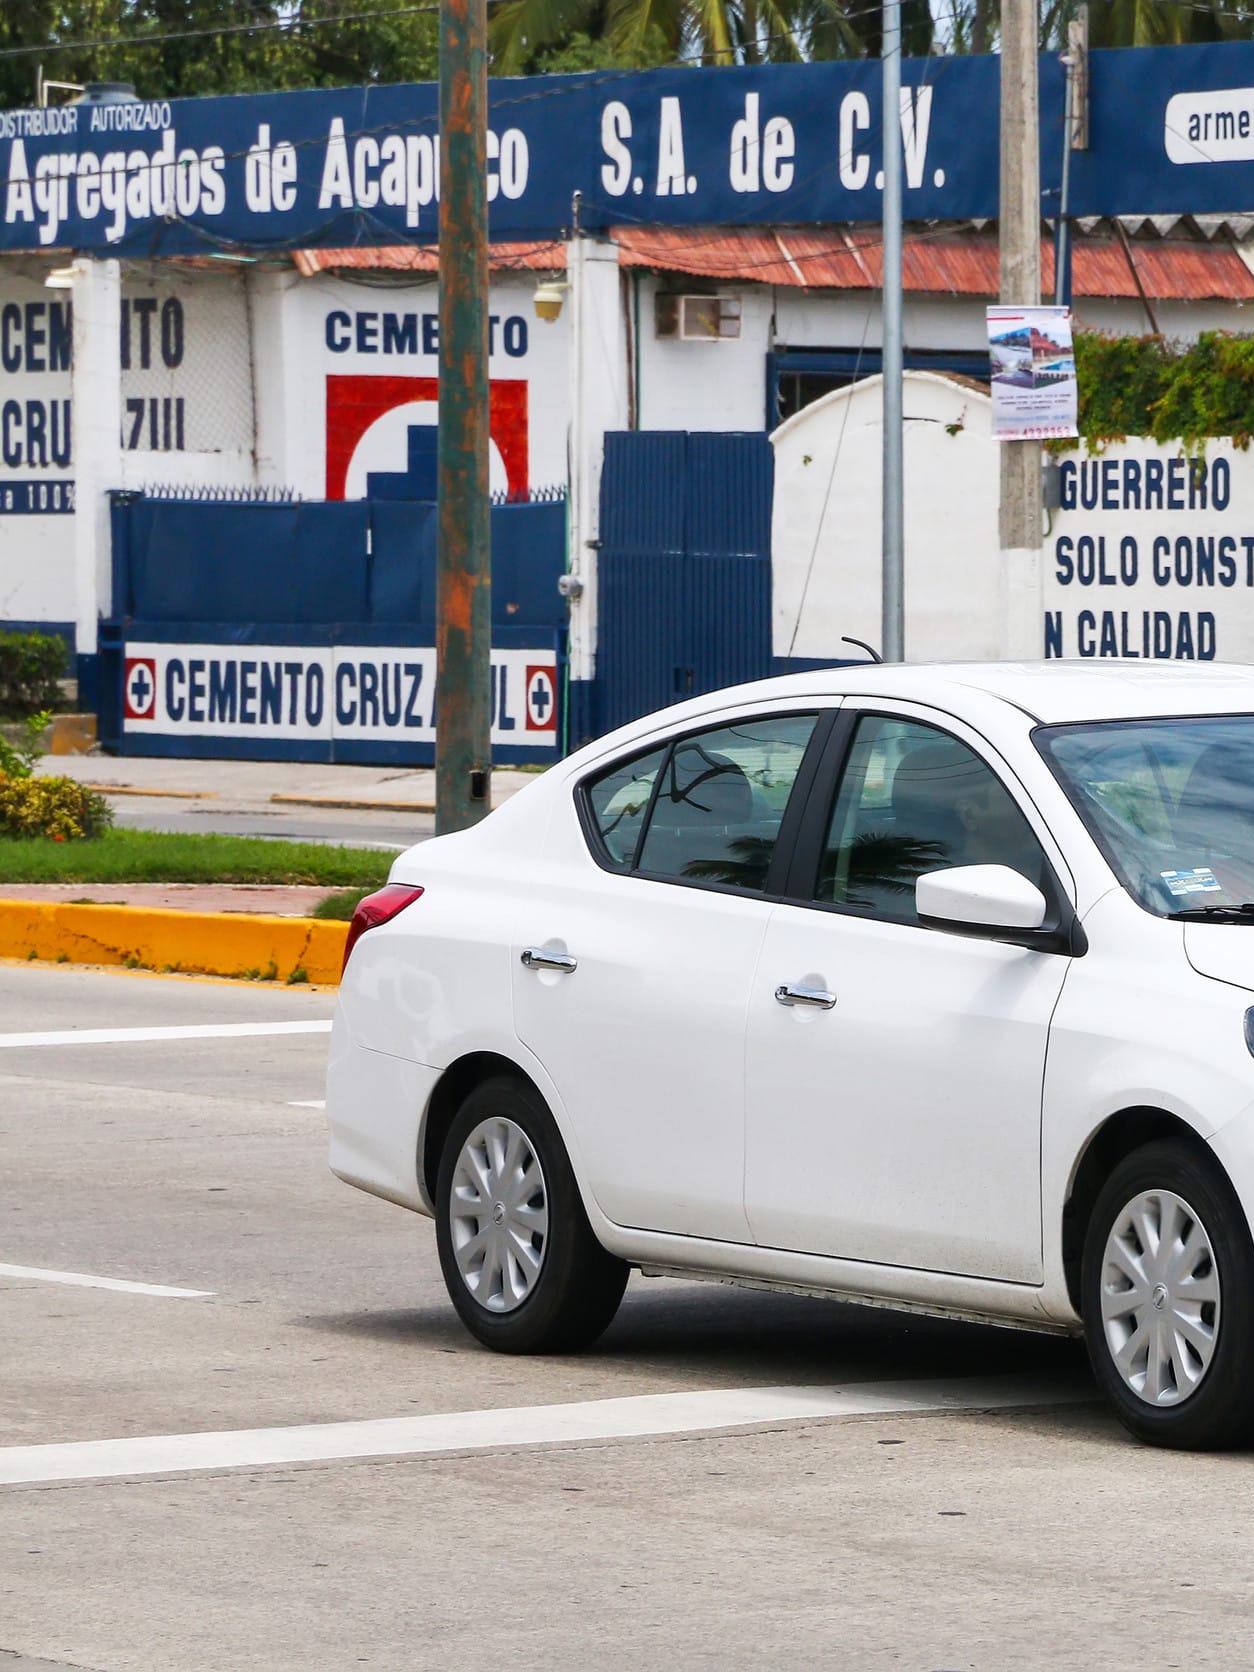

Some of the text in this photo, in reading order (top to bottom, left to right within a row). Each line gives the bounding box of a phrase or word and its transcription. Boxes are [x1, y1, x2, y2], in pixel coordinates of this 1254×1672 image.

[90, 103, 171, 132] AUTORIZADO
[5, 85, 945, 245] Agregados de Acapco S.A. de C.V.
[324, 310, 529, 358] CEMETO
[2, 400, 72, 469] CRU
[1060, 457, 1231, 511] GUERRERO
[1056, 535, 1139, 587] SOLO
[1078, 610, 1216, 660] CALIDAD
[165, 658, 324, 728] CEMENTO
[334, 661, 424, 728] CRUZ
